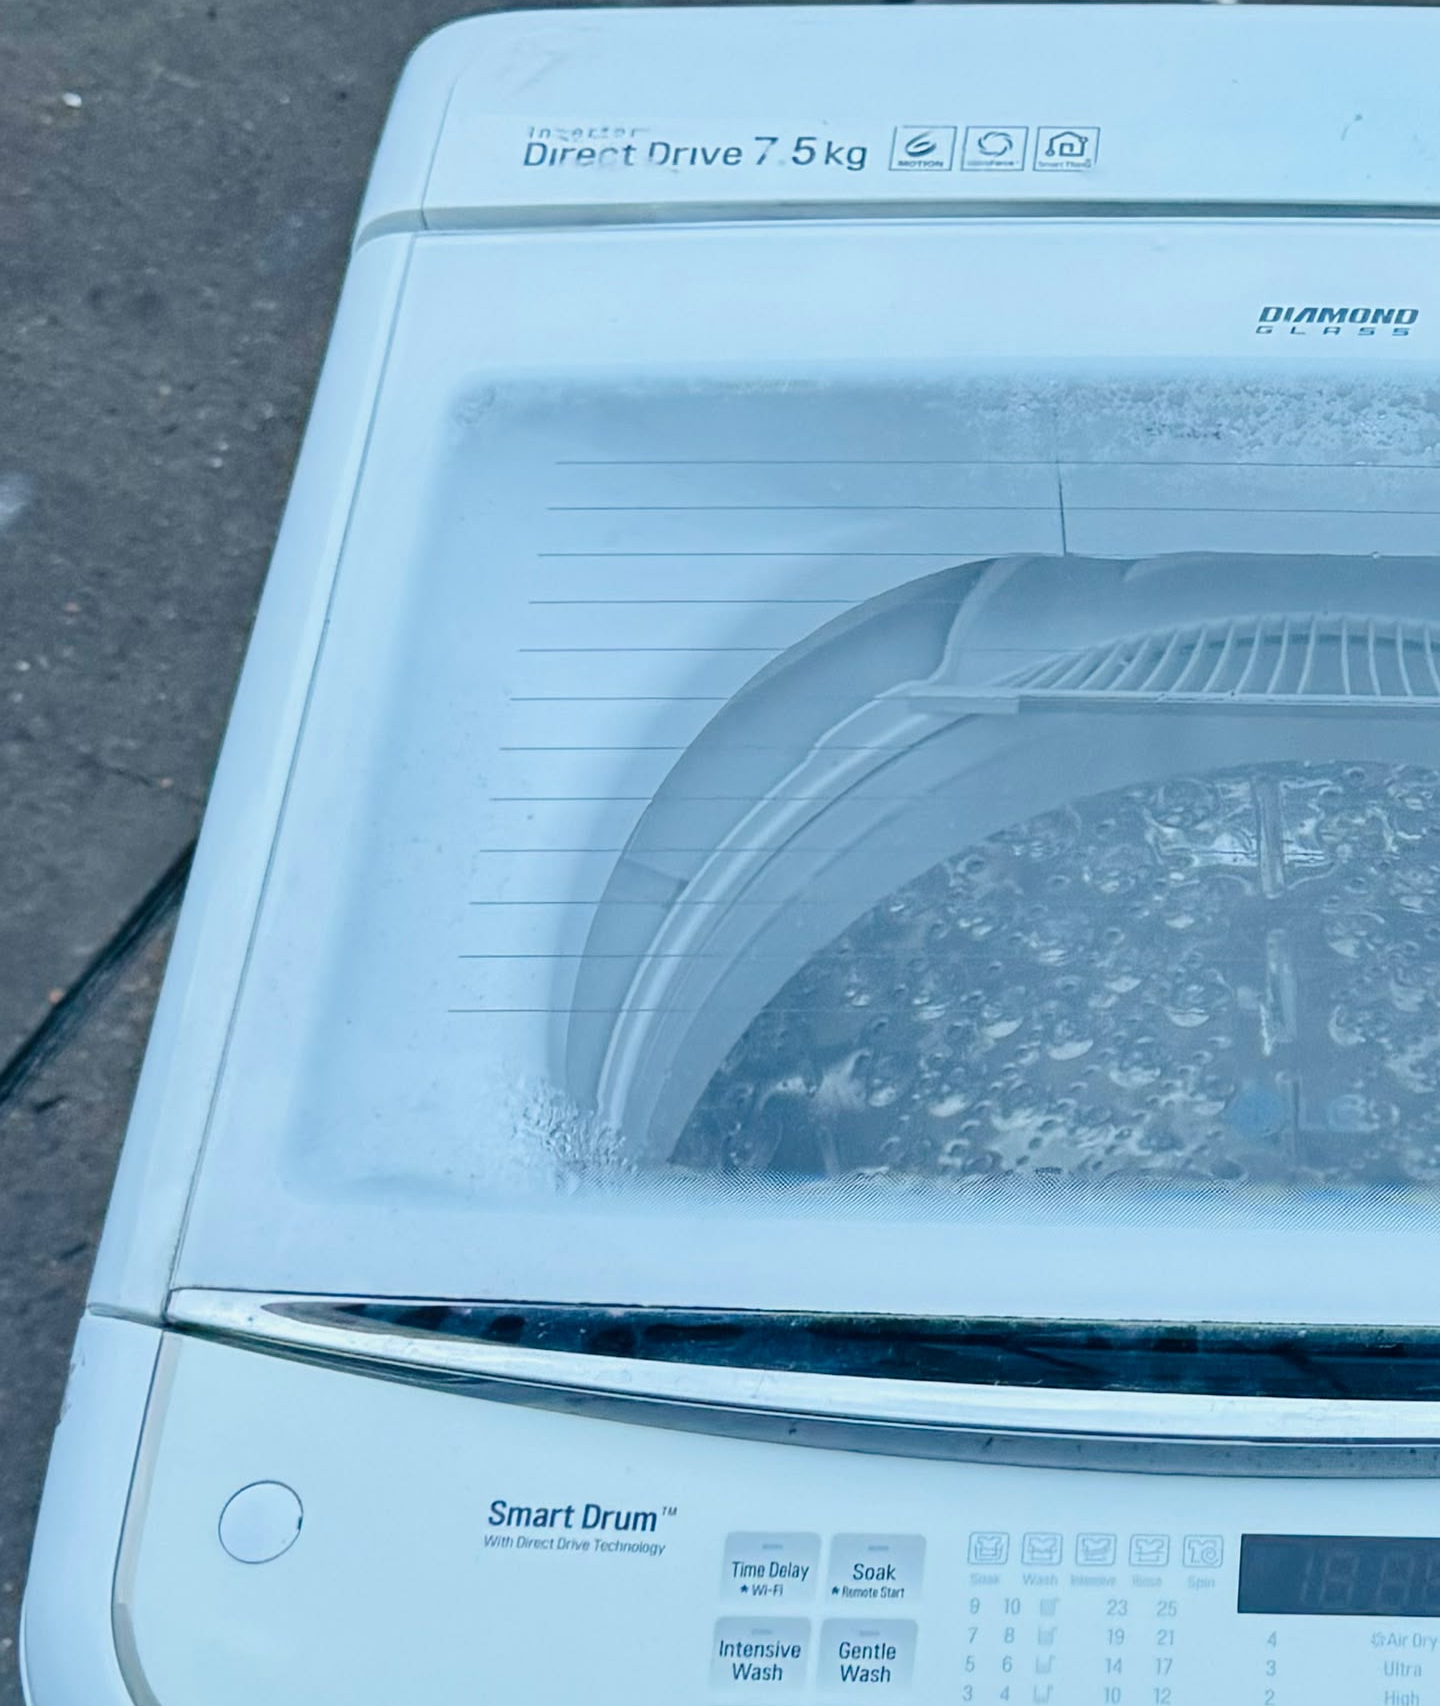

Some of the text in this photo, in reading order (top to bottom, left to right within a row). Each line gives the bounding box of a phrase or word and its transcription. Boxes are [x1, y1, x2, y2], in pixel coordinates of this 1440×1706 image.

[1258, 306, 1419, 325] DIAMOND
[1255, 325, 1411, 336] GLASS
[488, 1500, 575, 1529] Smart
[484, 1534, 666, 1557] With Direct Drive Technology
[732, 1560, 810, 1582] Time Delay
[852, 1563, 897, 1581] Soak
[1187, 1575, 1216, 1589] Spin
[842, 1586, 905, 1599] Remote Start
[1004, 1597, 1021, 1615] 10
[1107, 1599, 1128, 1617] 23
[1156, 1600, 1177, 1617] 25
[968, 1626, 978, 1643] 7
[1004, 1626, 1015, 1643] 8
[1107, 1628, 1125, 1645] 19
[1156, 1629, 1174, 1646] 21
[1267, 1631, 1277, 1647] 4
[1387, 1632, 1438, 1651] Air Dry
[719, 1639, 802, 1660] Intensive
[838, 1641, 897, 1661] Gentle
[965, 1655, 975, 1672] 5
[1002, 1655, 1013, 1673] 6
[1105, 1657, 1122, 1674] 14
[1155, 1658, 1173, 1675] 17
[1266, 1660, 1276, 1677] 3
[1383, 1661, 1422, 1677] Ultra
[732, 1663, 784, 1682] Wash
[840, 1665, 891, 1684] Wash
[962, 1684, 973, 1701] 3
[1000, 1685, 1010, 1701] 4
[1104, 1687, 1121, 1704] 10
[1154, 1687, 1171, 1705] 12
[1264, 1690, 1275, 1706] 2
